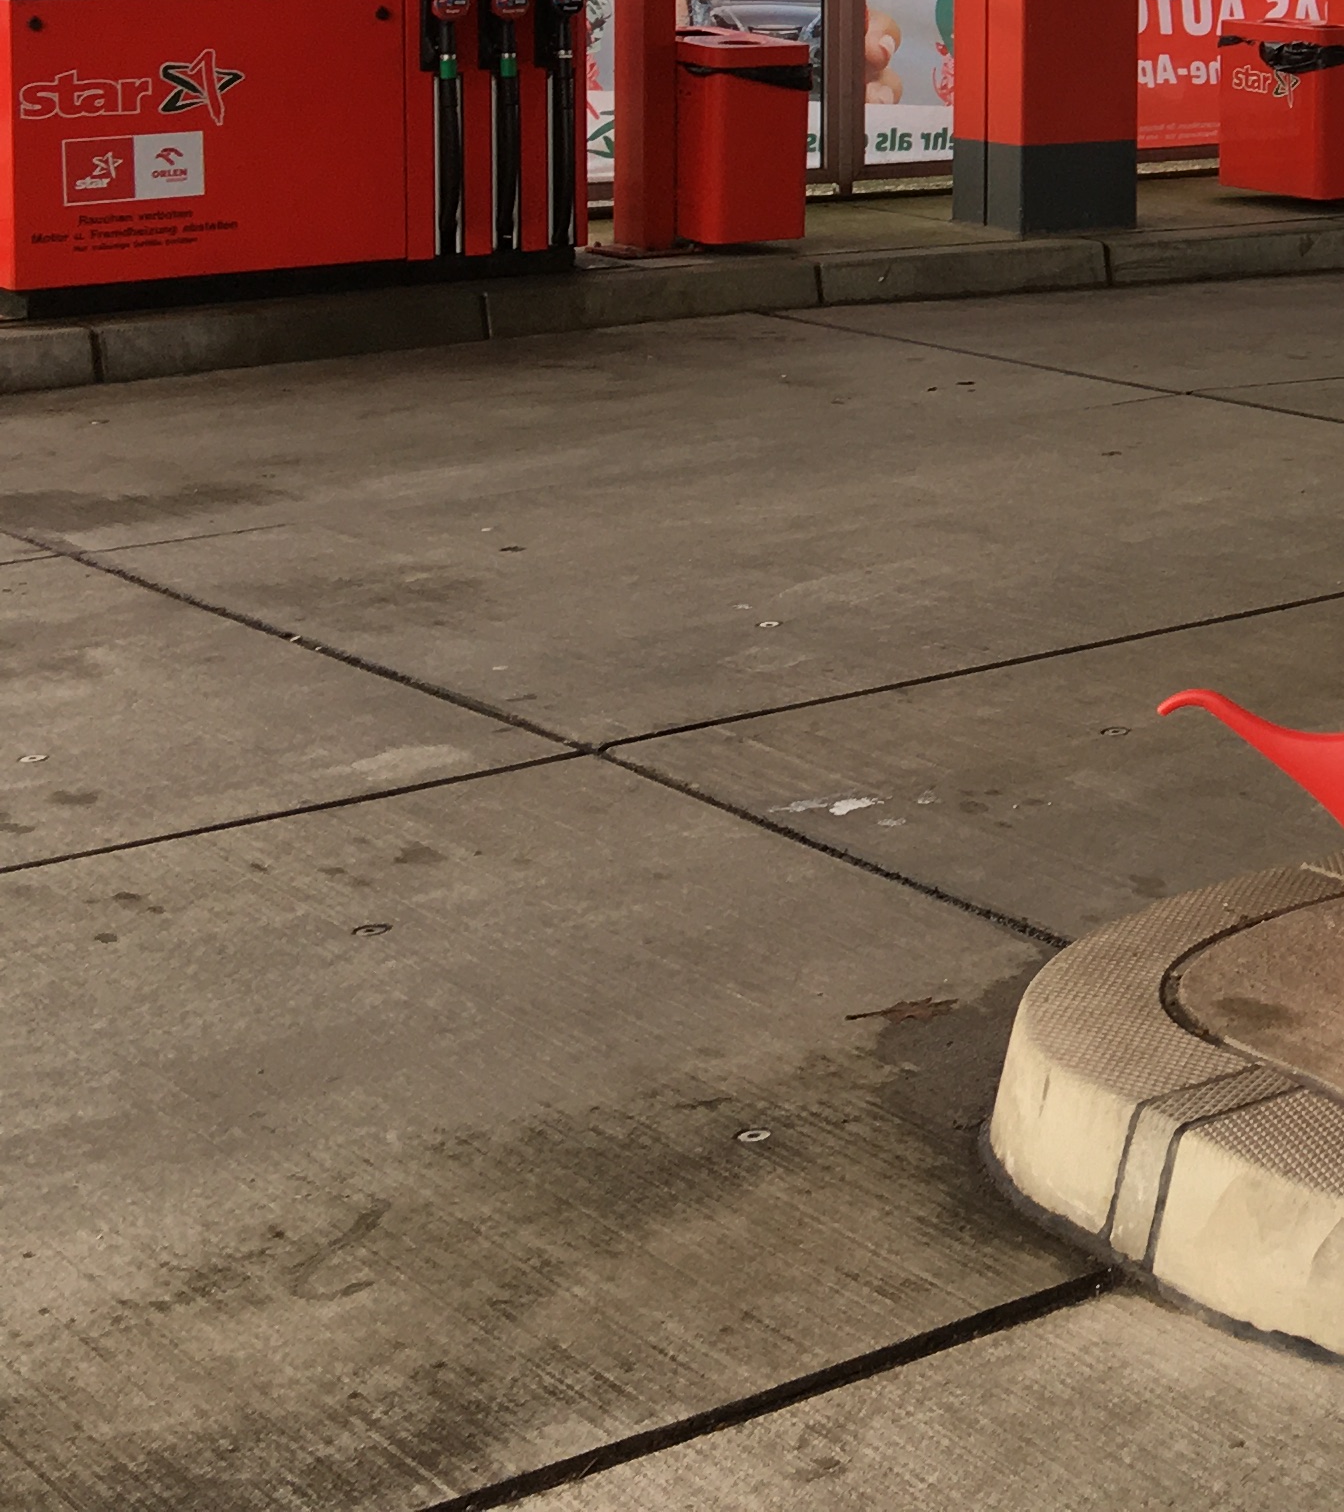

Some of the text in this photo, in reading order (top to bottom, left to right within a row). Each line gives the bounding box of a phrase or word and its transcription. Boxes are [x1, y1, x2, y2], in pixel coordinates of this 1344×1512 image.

[1232, 65, 1273, 94] star
[19, 69, 152, 120] star
[75, 175, 111, 190] star
[152, 168, 188, 179] ORLEN
